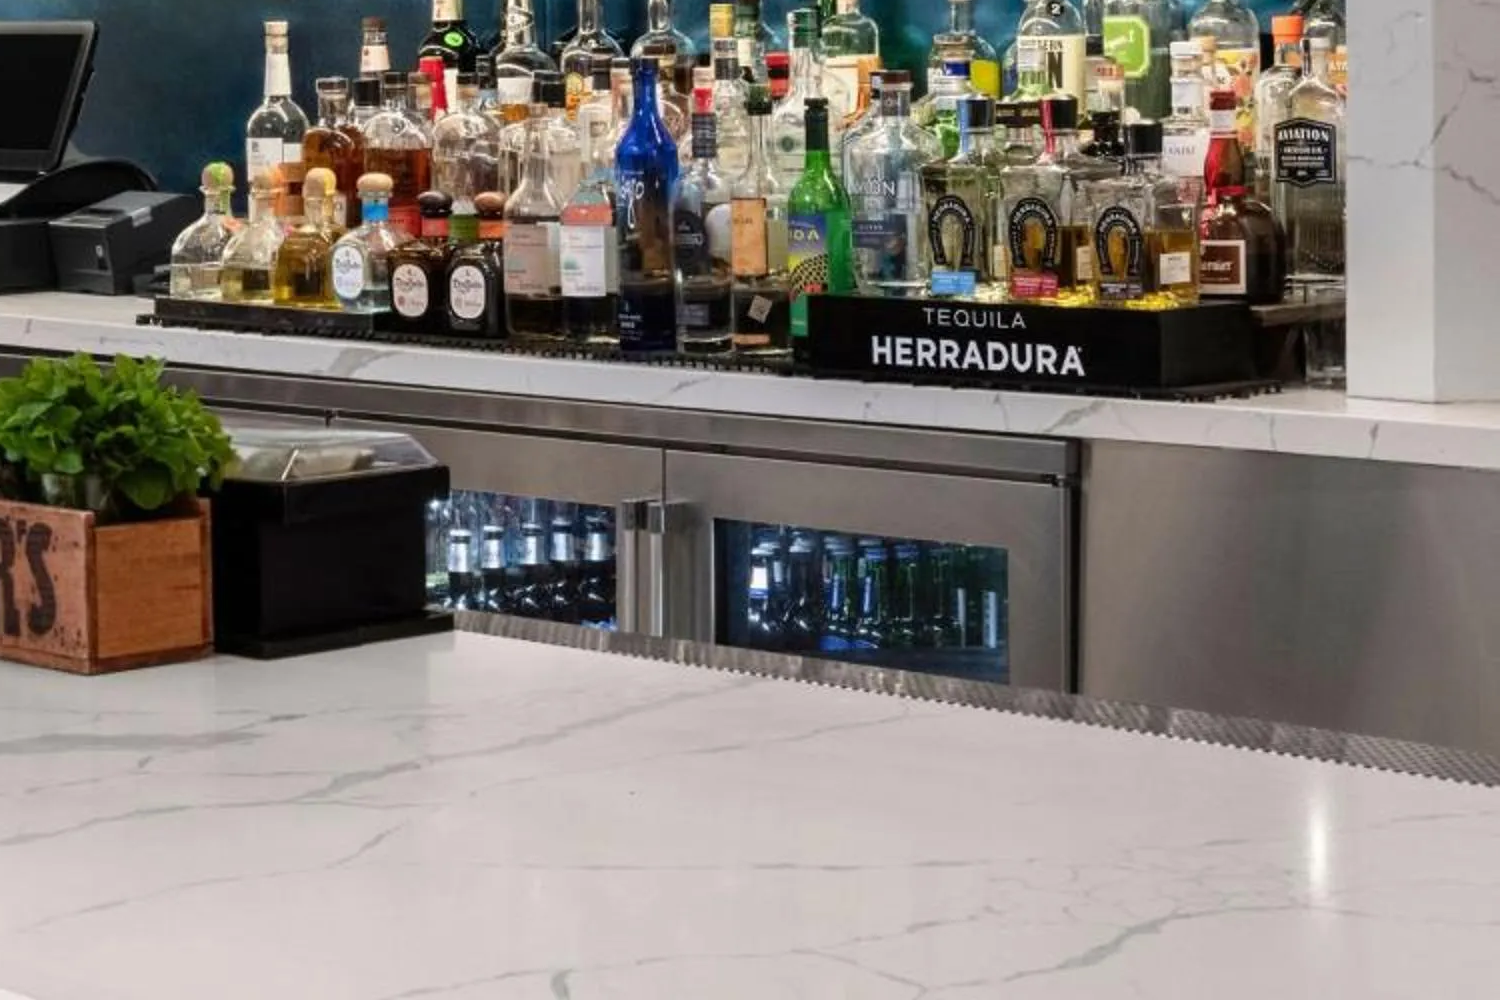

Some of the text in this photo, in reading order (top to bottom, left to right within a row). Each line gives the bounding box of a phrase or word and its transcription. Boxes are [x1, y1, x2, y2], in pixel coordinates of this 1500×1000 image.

[1278, 127, 1329, 142] AVIATION
[923, 307, 1027, 329] TEQUILA
[871, 335, 1086, 377] HERRADURA
